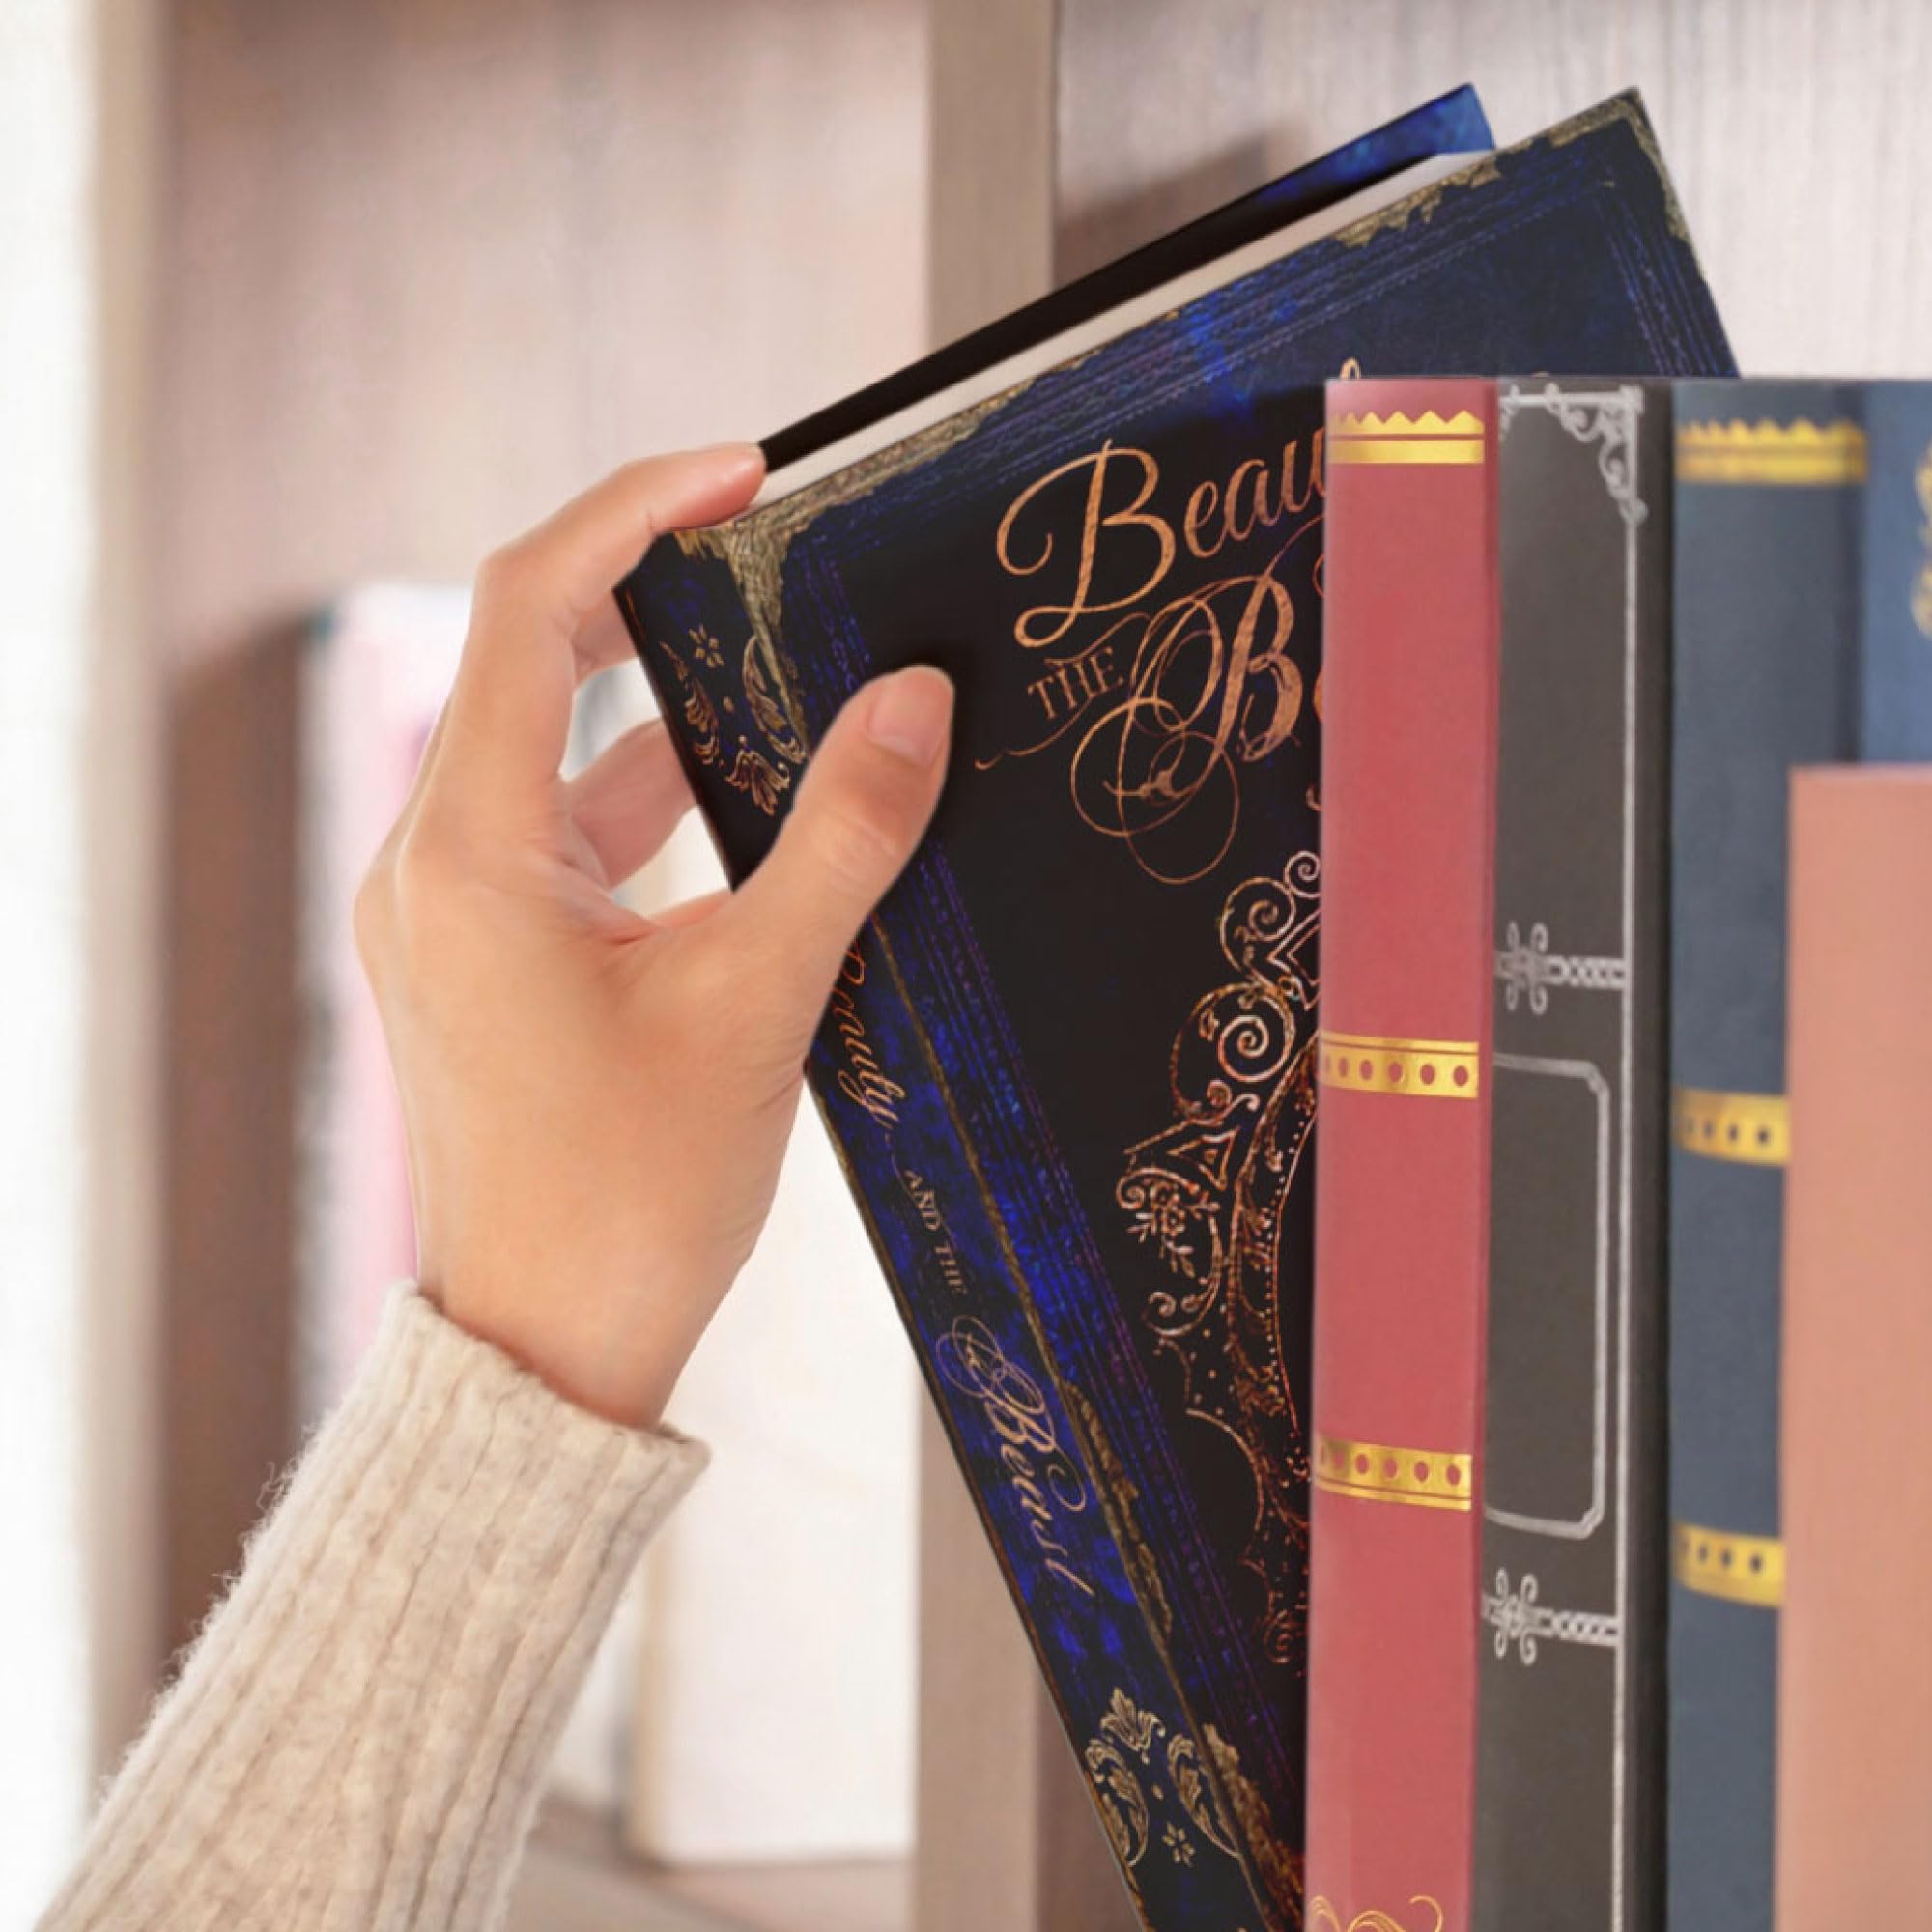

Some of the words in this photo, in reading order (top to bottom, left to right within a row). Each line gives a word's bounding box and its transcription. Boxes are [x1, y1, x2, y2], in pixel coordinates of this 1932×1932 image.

[997, 424, 1325, 649] Beau
[1027, 645, 1123, 721] THE
[902, 1170, 941, 1231] AND
[934, 1241, 968, 1295] THE
[936, 1315, 1095, 1595] Beast
